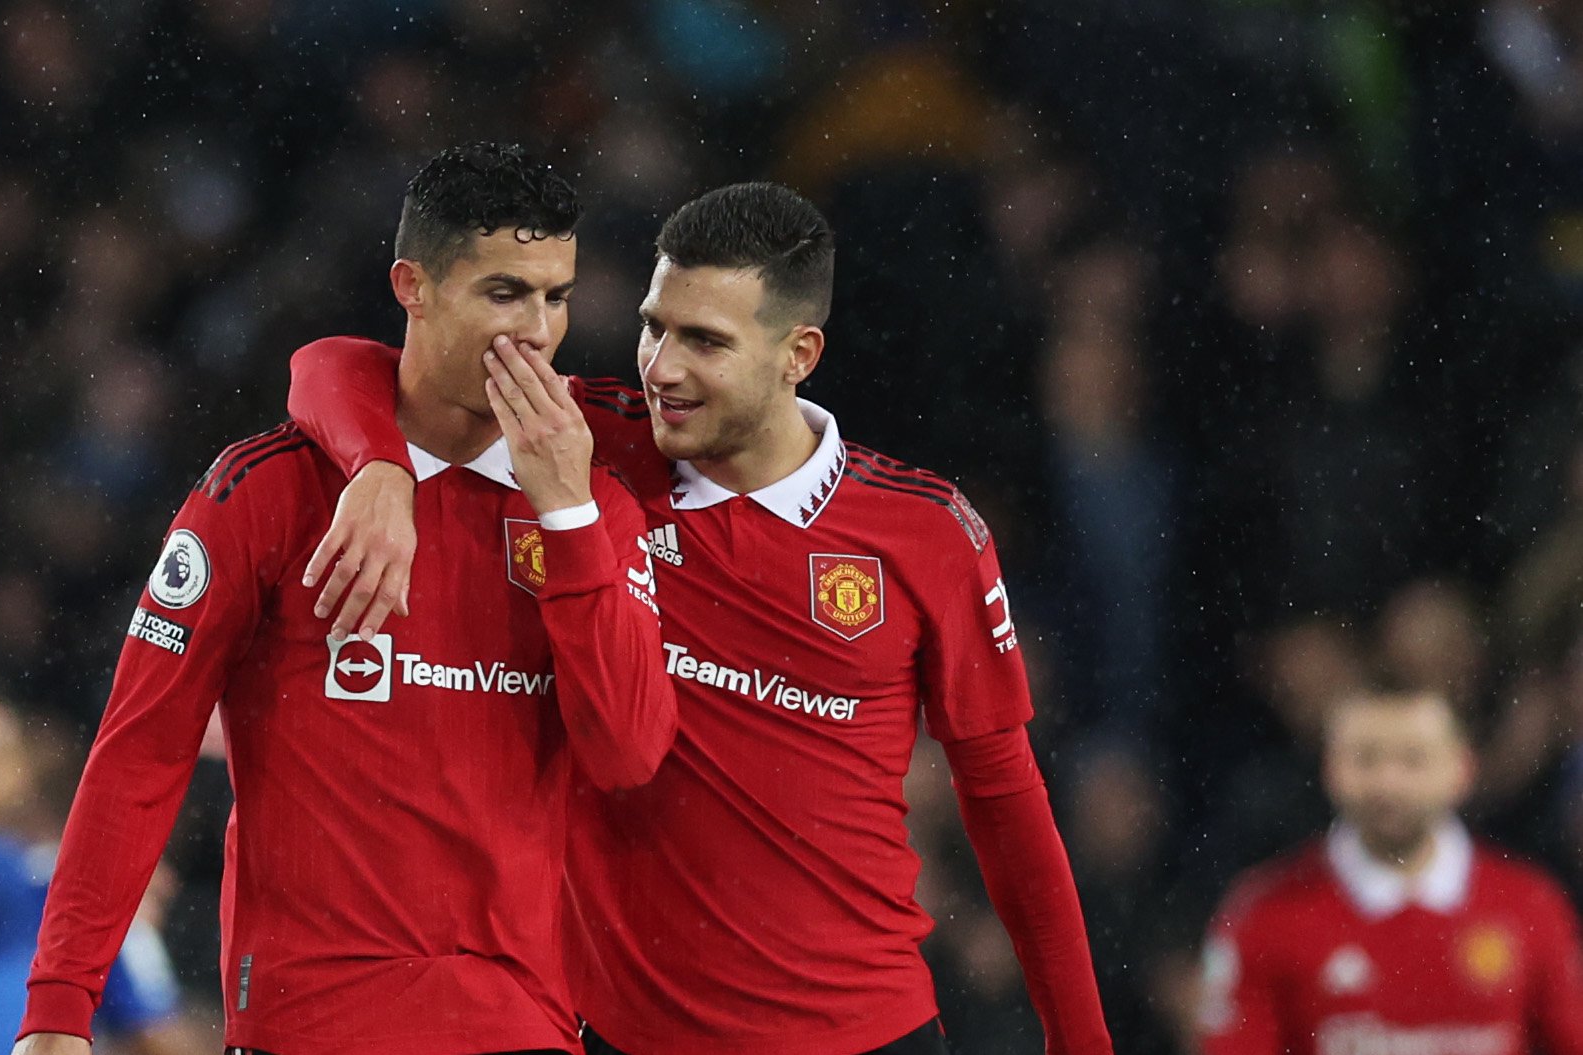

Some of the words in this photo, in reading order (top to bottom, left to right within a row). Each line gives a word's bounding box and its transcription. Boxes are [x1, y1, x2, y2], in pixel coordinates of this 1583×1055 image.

[648, 541, 684, 566] idas
[145, 614, 185, 640] room
[832, 610, 866, 621] UNITED
[139, 626, 186, 655] racism
[395, 653, 556, 696] TeamViewr
[662, 642, 861, 721] TeamViewer
